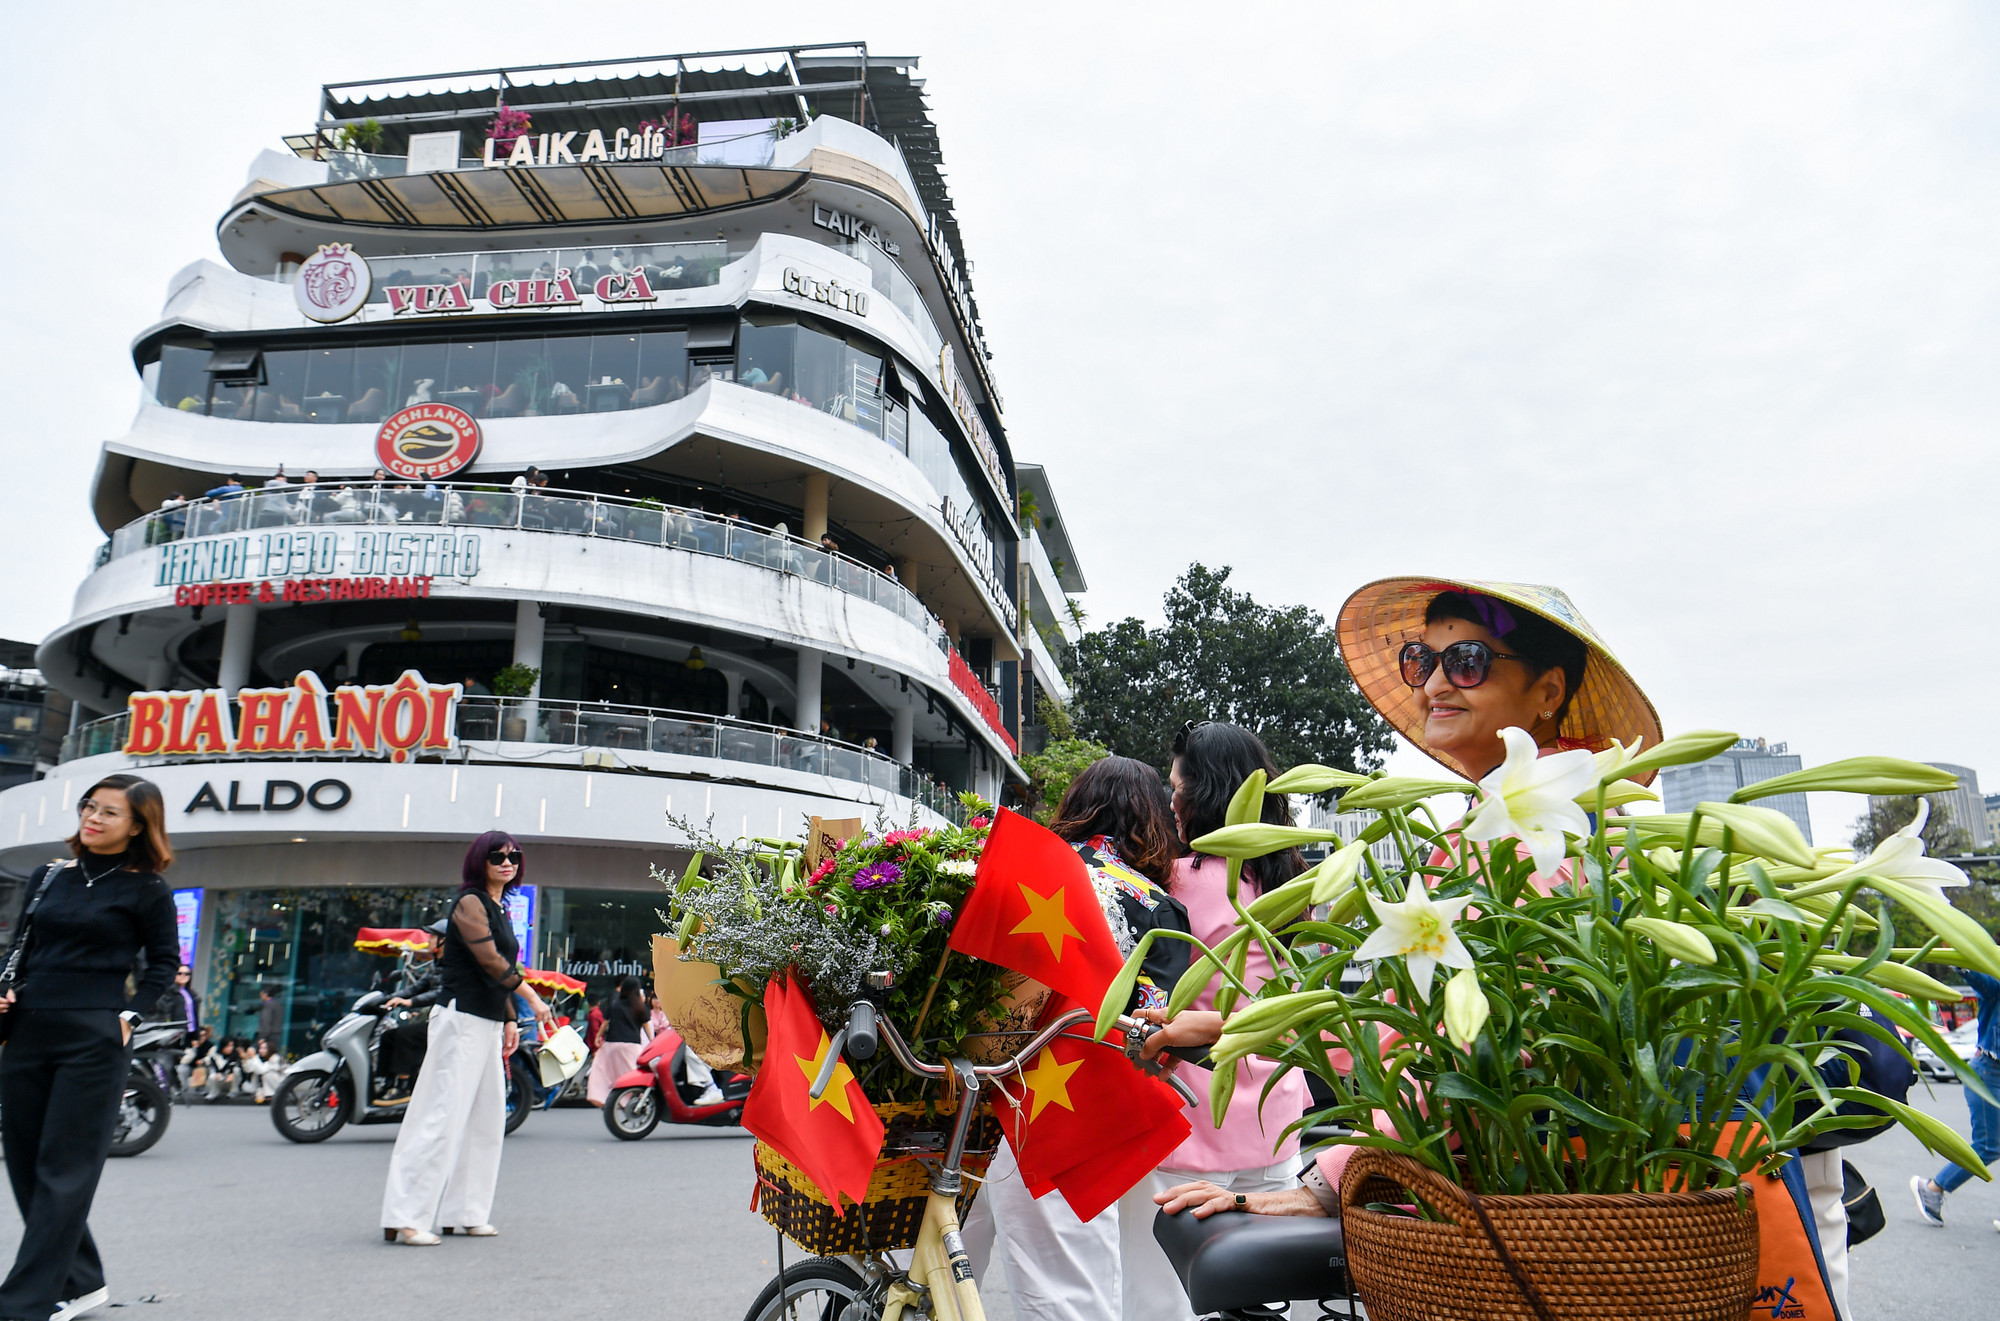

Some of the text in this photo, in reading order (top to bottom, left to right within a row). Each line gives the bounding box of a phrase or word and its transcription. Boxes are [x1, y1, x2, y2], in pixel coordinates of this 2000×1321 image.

[483, 129, 609, 167] LAIKA
[615, 125, 667, 160] Café
[813, 201, 882, 248] LAIKA
[383, 265, 658, 314] VUA CHẢ CÁ
[845, 288, 870, 316] 10
[381, 407, 474, 440] HIGHLANDS
[390, 455, 461, 476] COFFEE
[154, 531, 481, 587] HANOI 1930 BISTRO
[944, 495, 994, 590] HIGHLANDS
[175, 576, 434, 607] COFFEE & RESTAURANT
[124, 671, 460, 764] BIA HÀ NỘI
[184, 778, 352, 813] ALDO
[1780, 1309, 1806, 1319] DONEX
